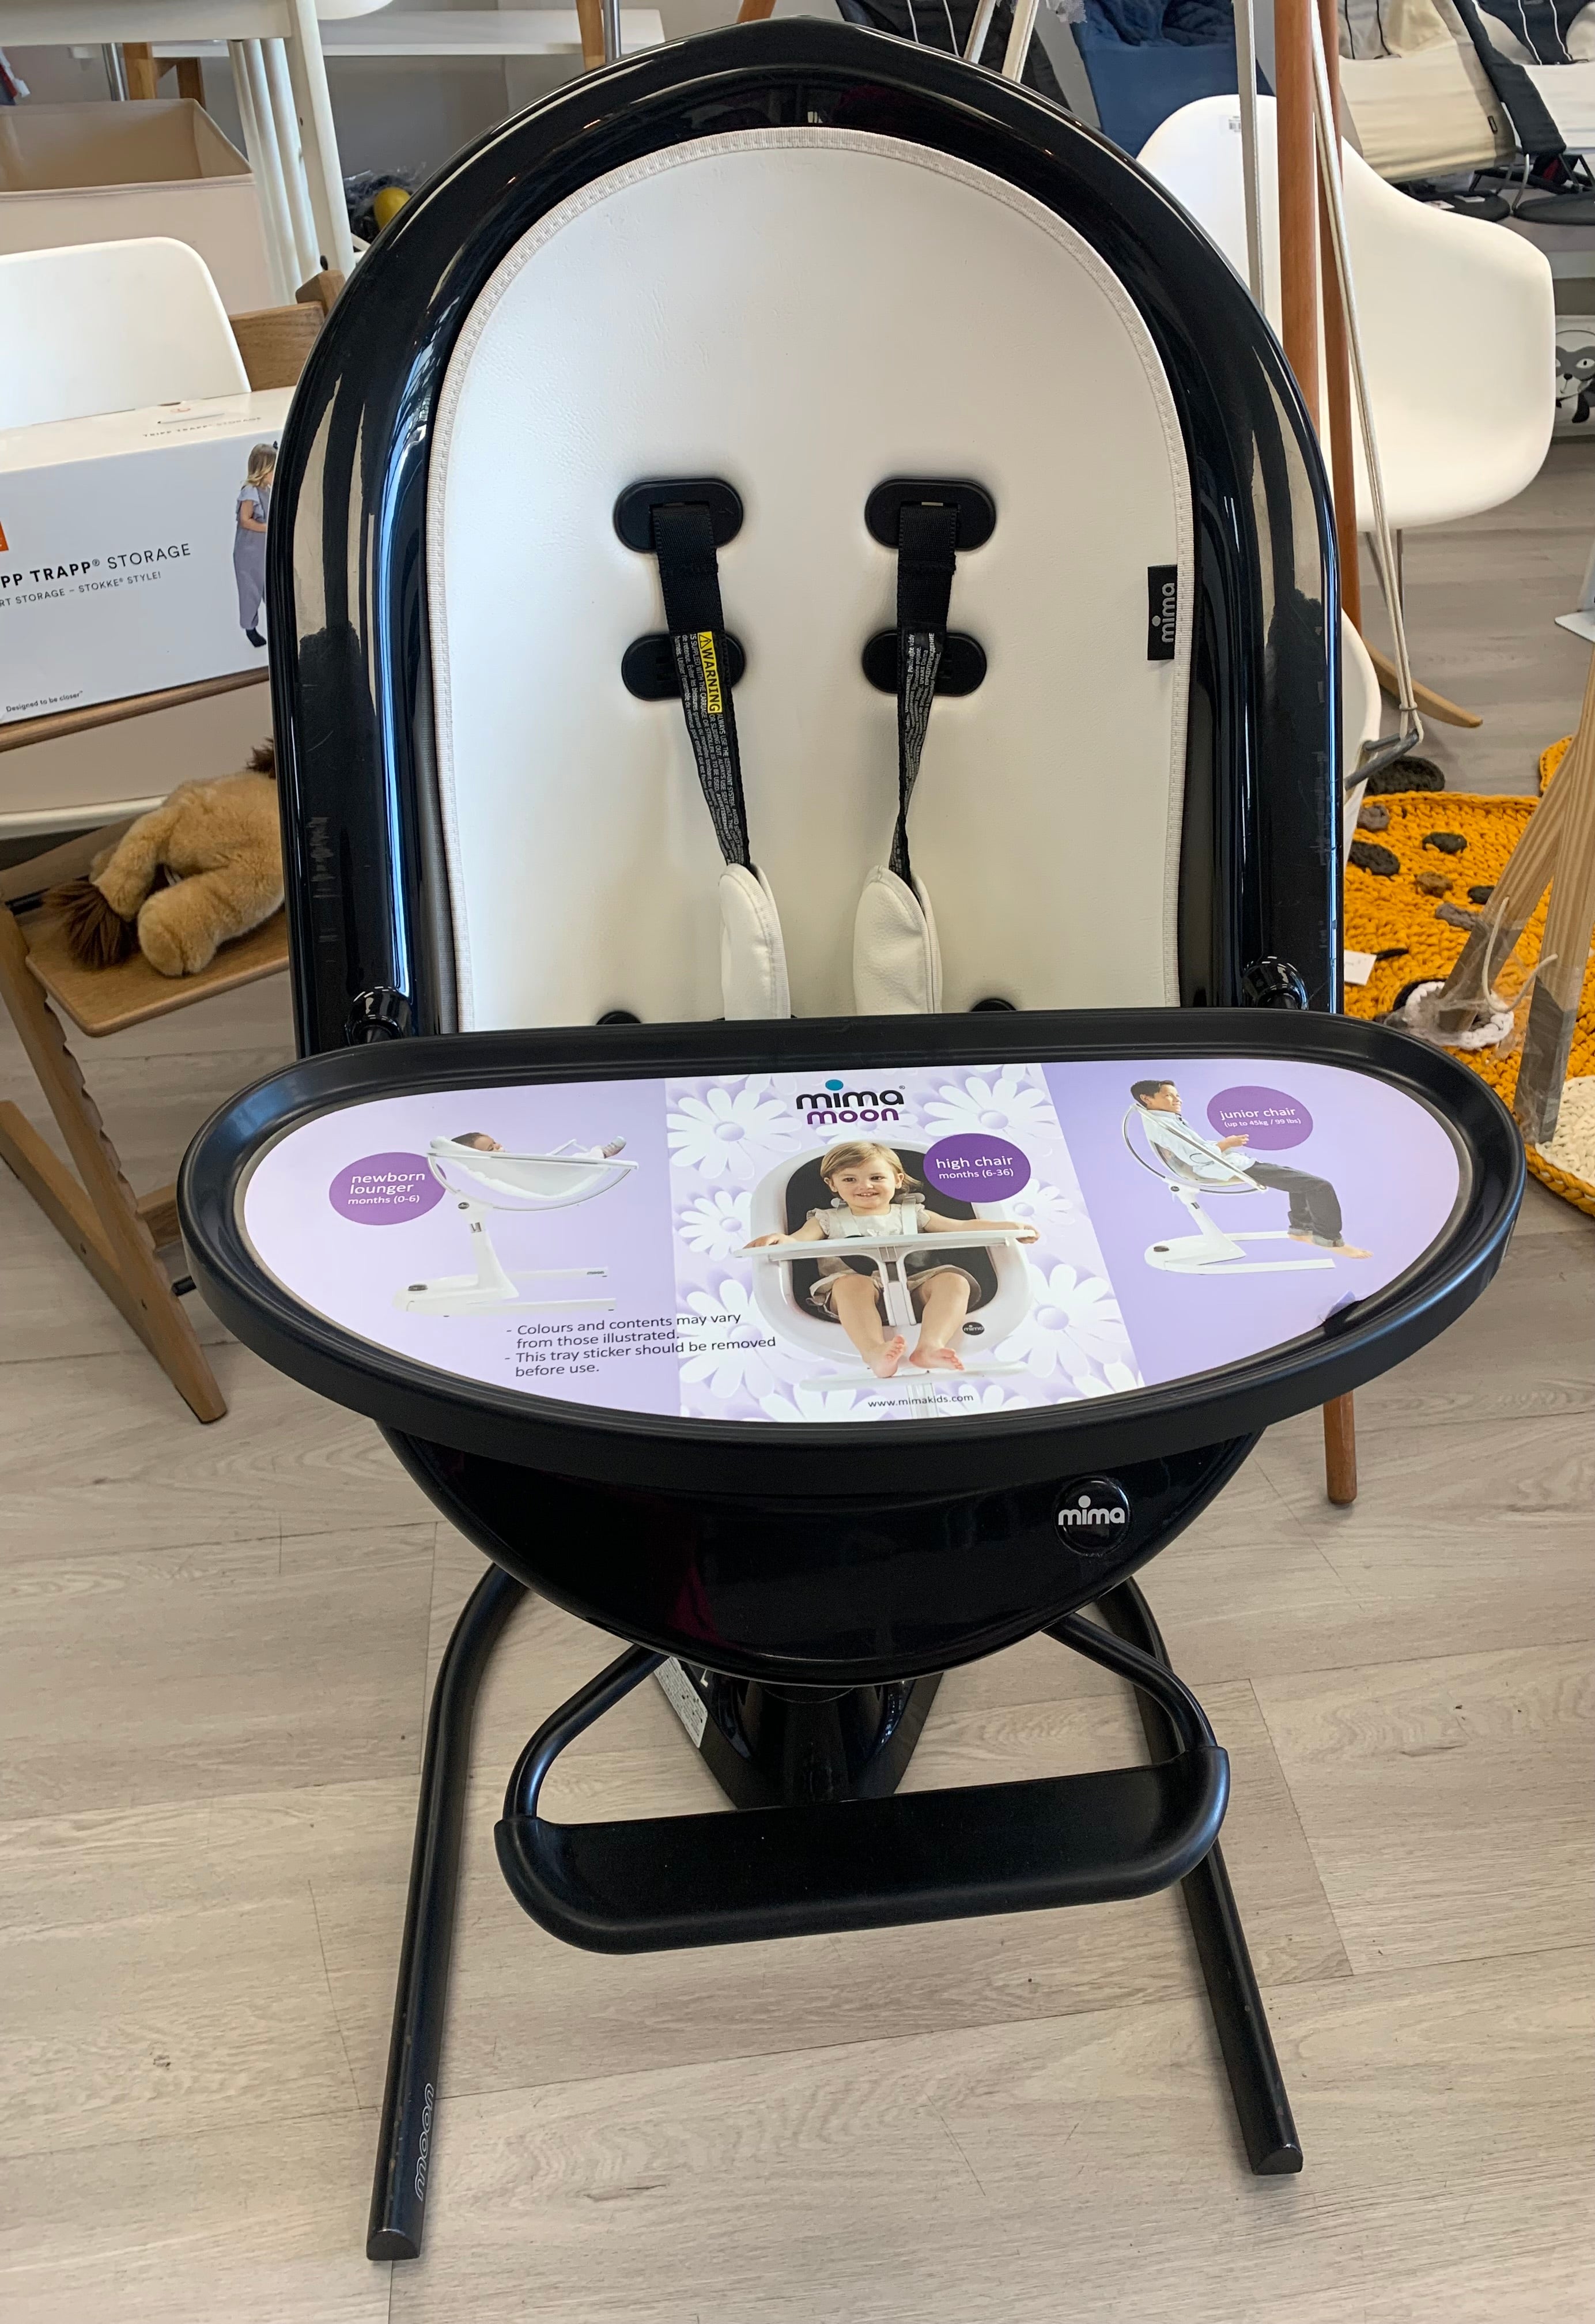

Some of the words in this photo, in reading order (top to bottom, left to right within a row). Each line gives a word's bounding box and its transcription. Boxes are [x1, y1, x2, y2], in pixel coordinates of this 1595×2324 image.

[108, 544, 191, 569] STORAGE
[16, 588, 65, 604] STORAGE
[127, 571, 161, 584] STYLE!
[1152, 583, 1175, 643] mima
[6, 700, 38, 712] Designed
[691, 641, 700, 665] SUPPLIED
[705, 728, 714, 753] STROLLER
[702, 648, 720, 711] WARNING
[717, 714, 726, 734] ALWAYS
[724, 758, 732, 786] RESTRAINT
[711, 723, 720, 744] SLIDING
[807, 1108, 899, 1124] moon
[1220, 1110, 1259, 1120] junior
[1264, 1108, 1295, 1116] chair
[936, 1157, 970, 1169] high
[975, 1156, 1012, 1167] chair
[352, 1172, 425, 1183] newborn
[939, 1171, 980, 1179] months
[982, 1168, 1014, 1178] (6-36)
[350, 1184, 414, 1194] lounger
[348, 1197, 390, 1205] months
[394, 1195, 419, 1204] (0-6)
[517, 1324, 573, 1335] Colours
[578, 1320, 604, 1331] and
[609, 1317, 672, 1329] contents
[677, 1316, 706, 1326] may
[711, 1314, 741, 1323] vary
[517, 1339, 552, 1349] from
[558, 1336, 599, 1346] those
[603, 1329, 679, 1344] illustrated.
[516, 1352, 546, 1363] This
[551, 1351, 579, 1361] tray
[584, 1346, 632, 1358] sticker
[636, 1342, 684, 1355] should
[689, 1342, 706, 1352] be
[712, 1337, 776, 1350] removed
[516, 1365, 564, 1376] before
[570, 1364, 599, 1374] use.
[868, 1394, 973, 1407] www.mimakids.com
[1059, 1495, 1125, 1525] mima
